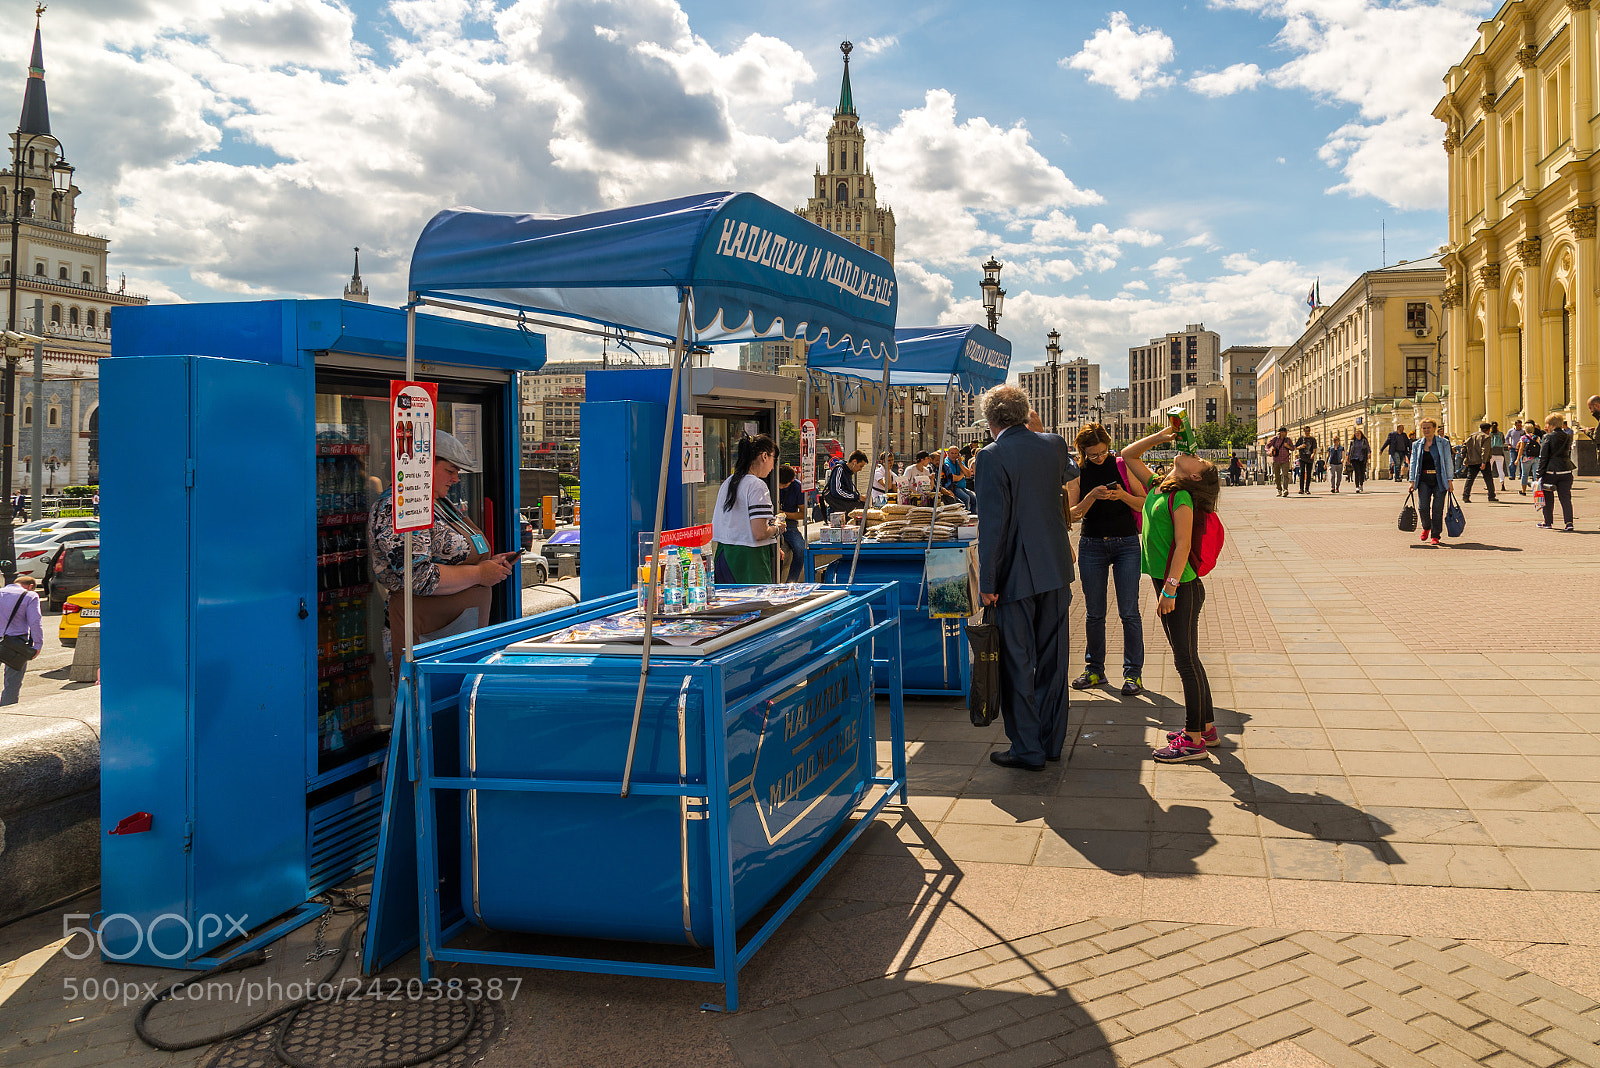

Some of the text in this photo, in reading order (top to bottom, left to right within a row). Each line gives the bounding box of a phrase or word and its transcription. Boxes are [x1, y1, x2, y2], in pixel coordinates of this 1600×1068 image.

[716, 218, 895, 307] НАПИТКИ И МОРОЖЕНОЕ
[784, 675, 849, 742] НАПИТКИ
[769, 719, 857, 816] МОРОЖЕНОЕ
